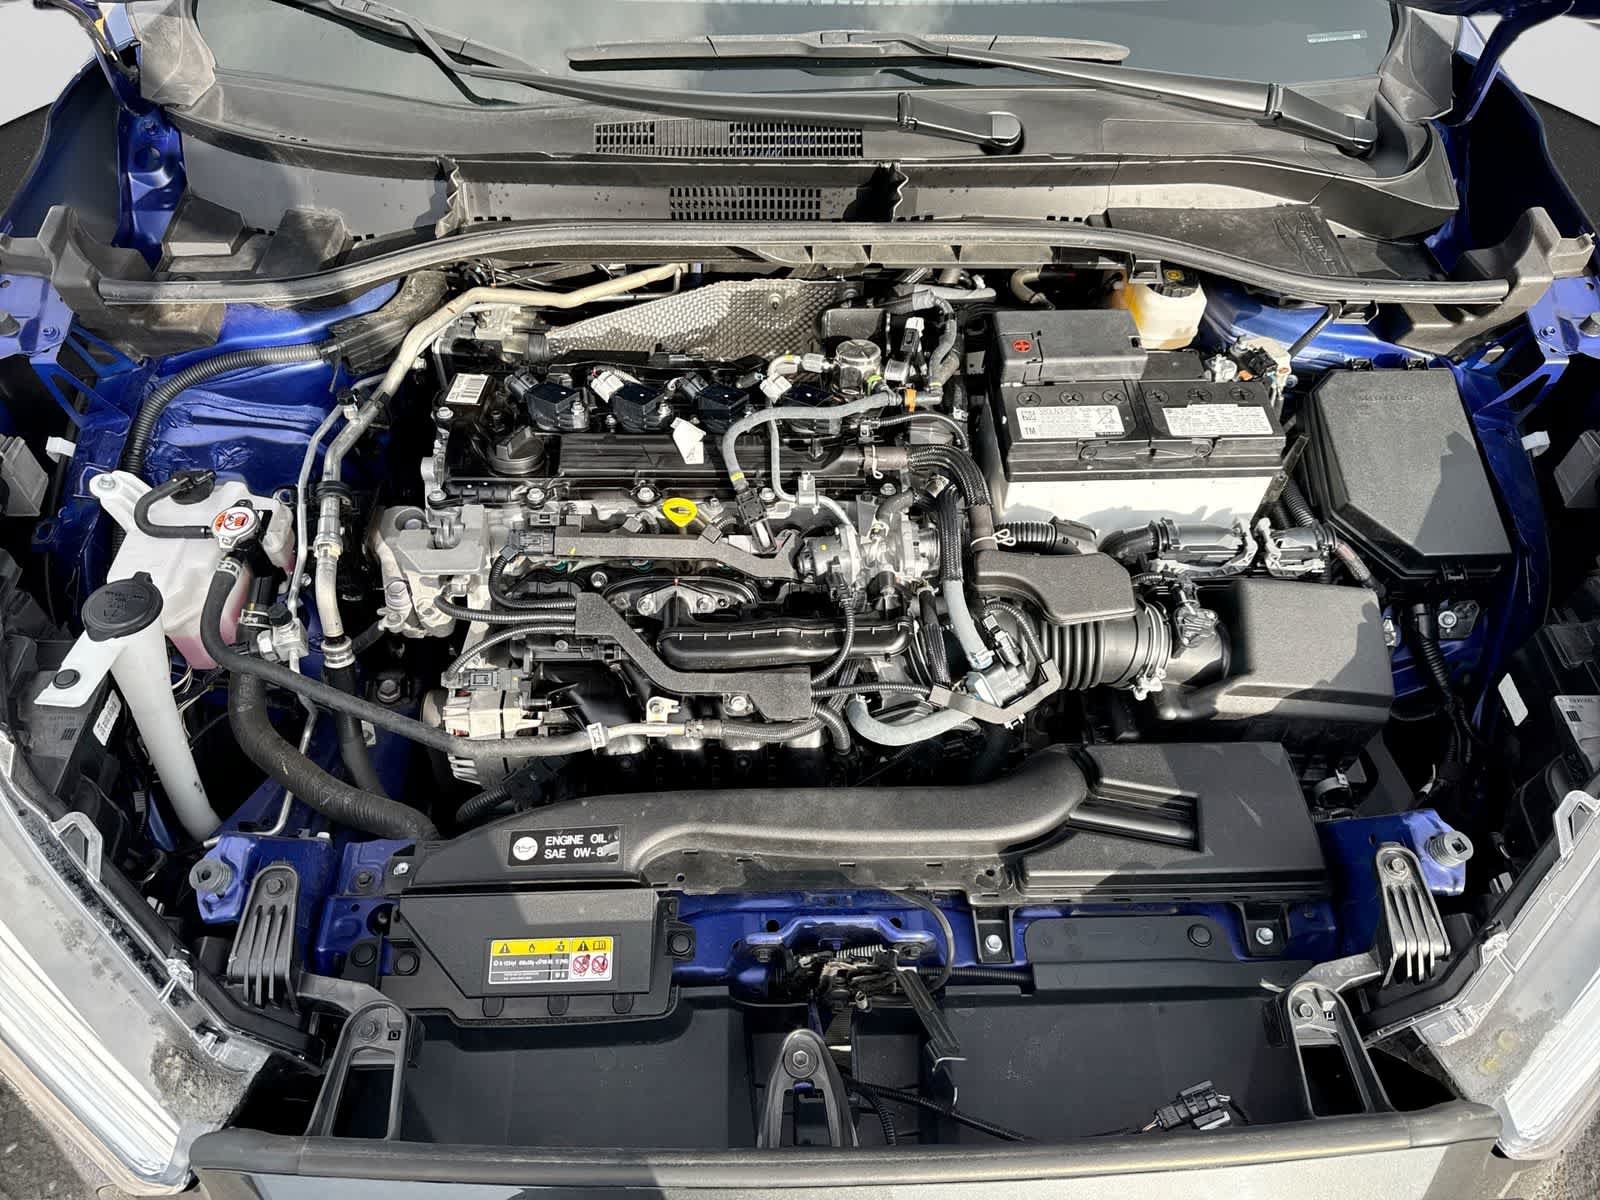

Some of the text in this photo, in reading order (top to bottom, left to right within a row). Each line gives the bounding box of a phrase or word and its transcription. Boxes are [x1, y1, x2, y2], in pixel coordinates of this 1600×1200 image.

[545, 833, 607, 846] ENGINE OIL
[544, 848, 567, 859] SAE
